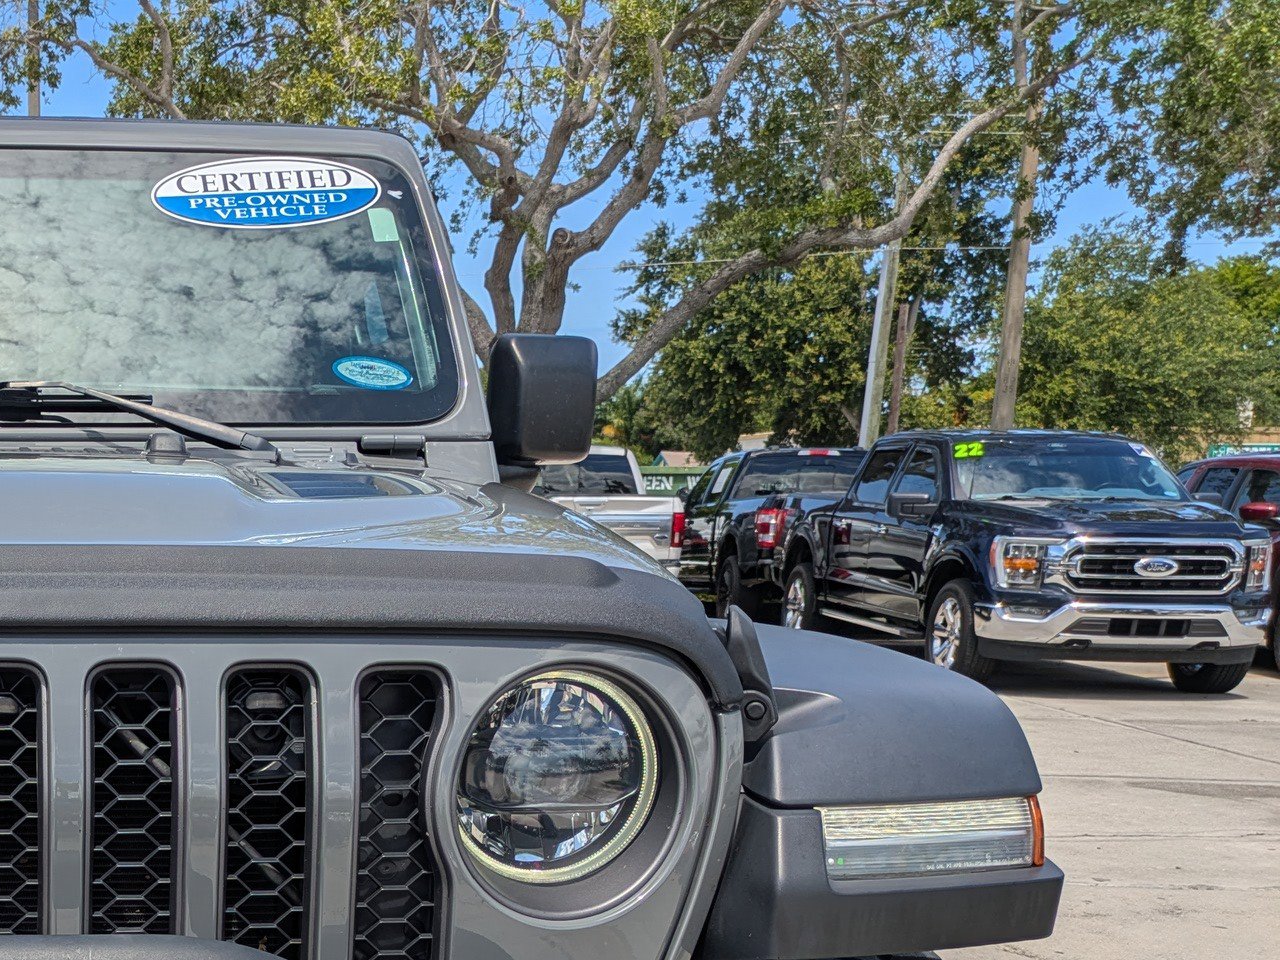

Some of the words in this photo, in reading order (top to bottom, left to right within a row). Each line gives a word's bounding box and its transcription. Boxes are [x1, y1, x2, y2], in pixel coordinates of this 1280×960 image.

[176, 168, 352, 194] CERTIFIED
[189, 192, 347, 209] PRE-OWNED
[214, 205, 328, 220] VEHICLE
[954, 442, 984, 458] 22
